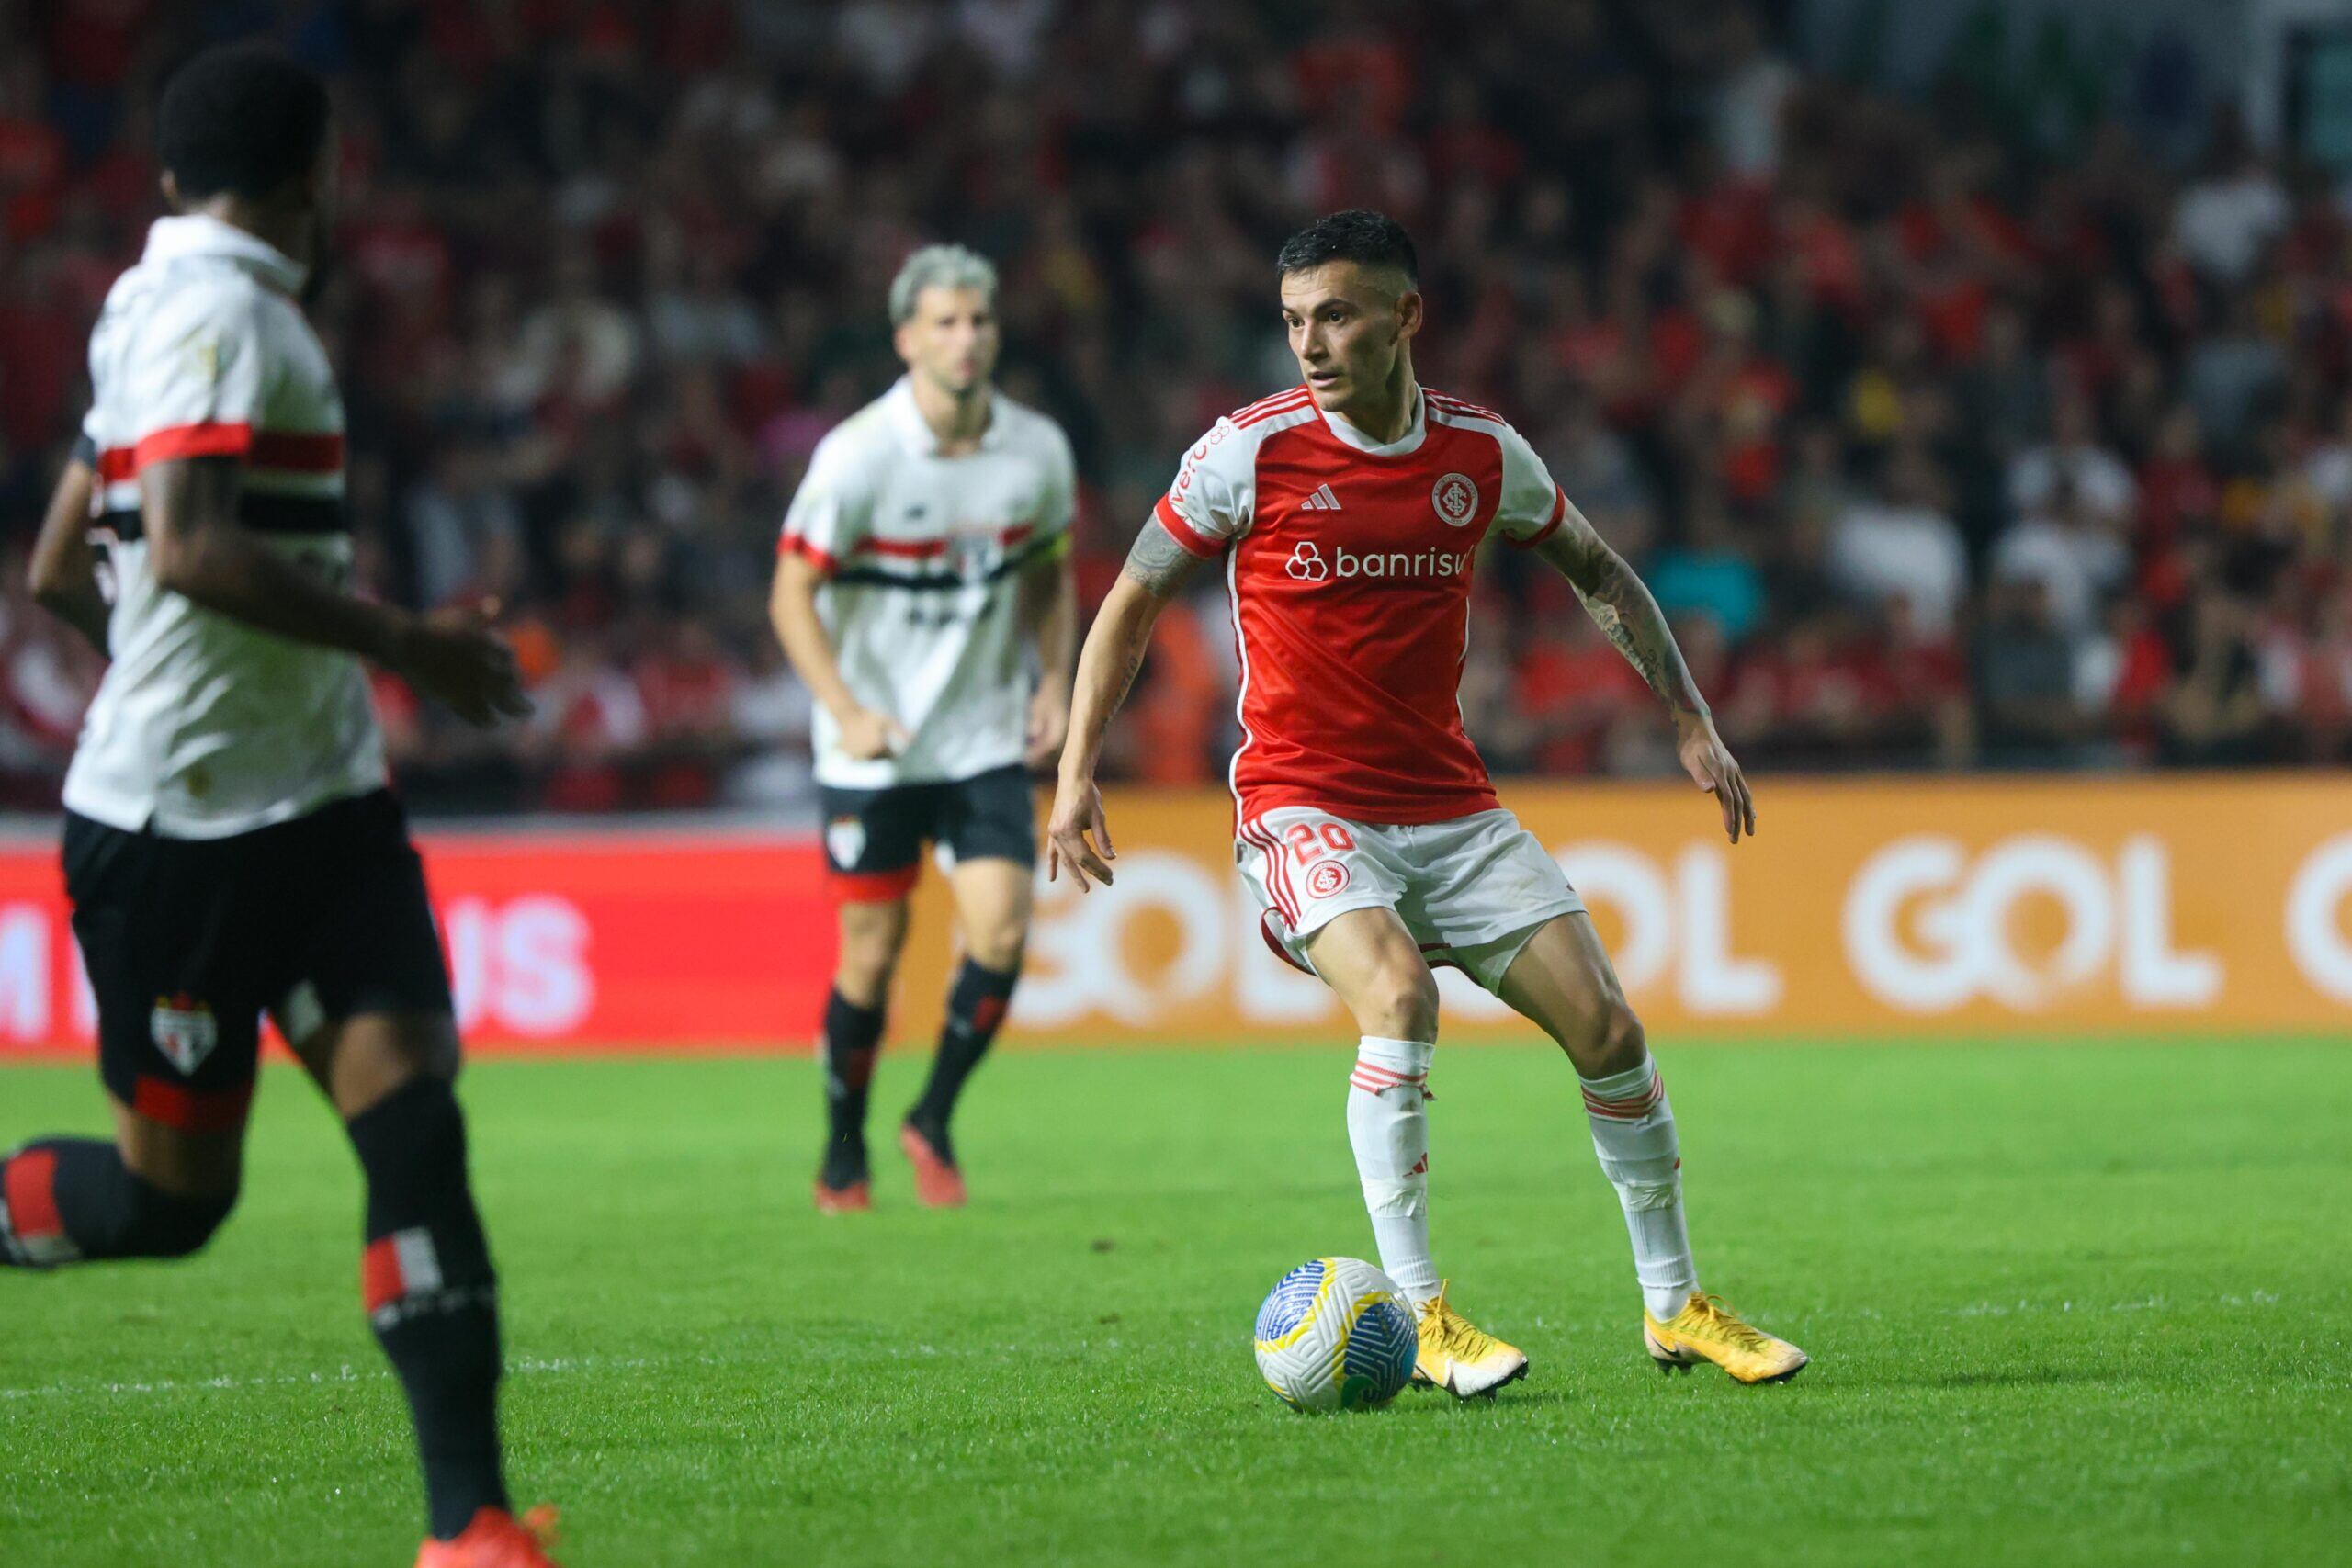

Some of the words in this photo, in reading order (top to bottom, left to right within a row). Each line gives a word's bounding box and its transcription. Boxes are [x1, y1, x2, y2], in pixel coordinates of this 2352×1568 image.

[1336, 545, 1475, 578] banrisu
[1285, 822, 1356, 867] 20
[1433, 840, 1784, 1020] OL
[1843, 834, 2222, 1013] GOL
